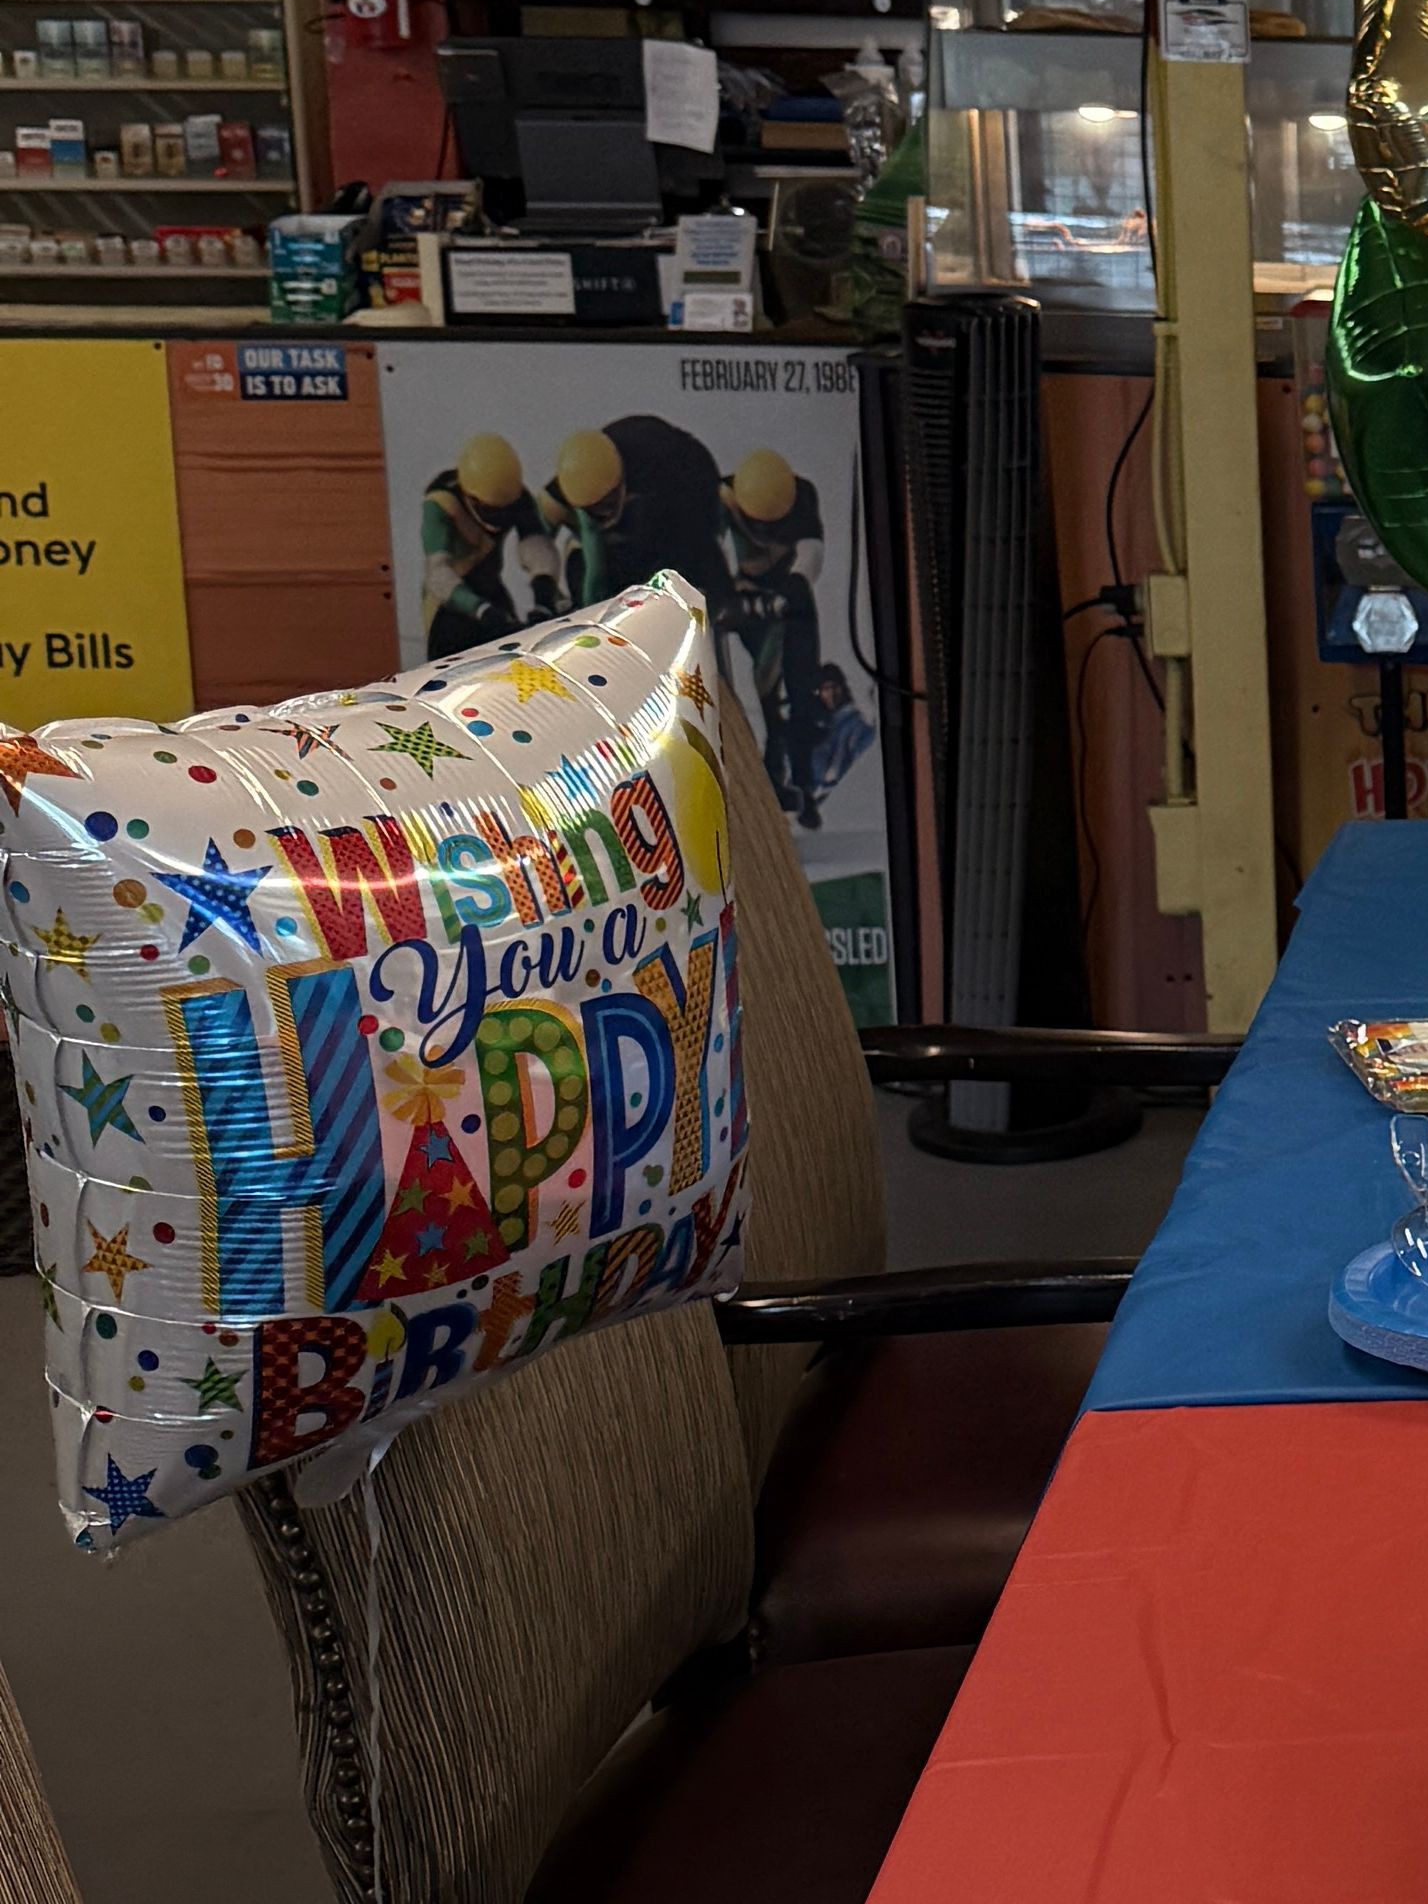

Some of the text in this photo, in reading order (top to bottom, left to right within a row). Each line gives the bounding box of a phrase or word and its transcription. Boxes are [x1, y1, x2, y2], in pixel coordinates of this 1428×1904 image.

[244, 349, 284, 369] OUR
[288, 349, 339, 369] TASK
[680, 359, 778, 392] FEBRUARY
[784, 361, 810, 395] 27,
[246, 375, 266, 395] IS
[269, 375, 297, 396] TO
[300, 375, 342, 395] ASK
[46, 633, 135, 670] Bills
[265, 770, 686, 962] Wishing
[369, 902, 647, 1070] You a
